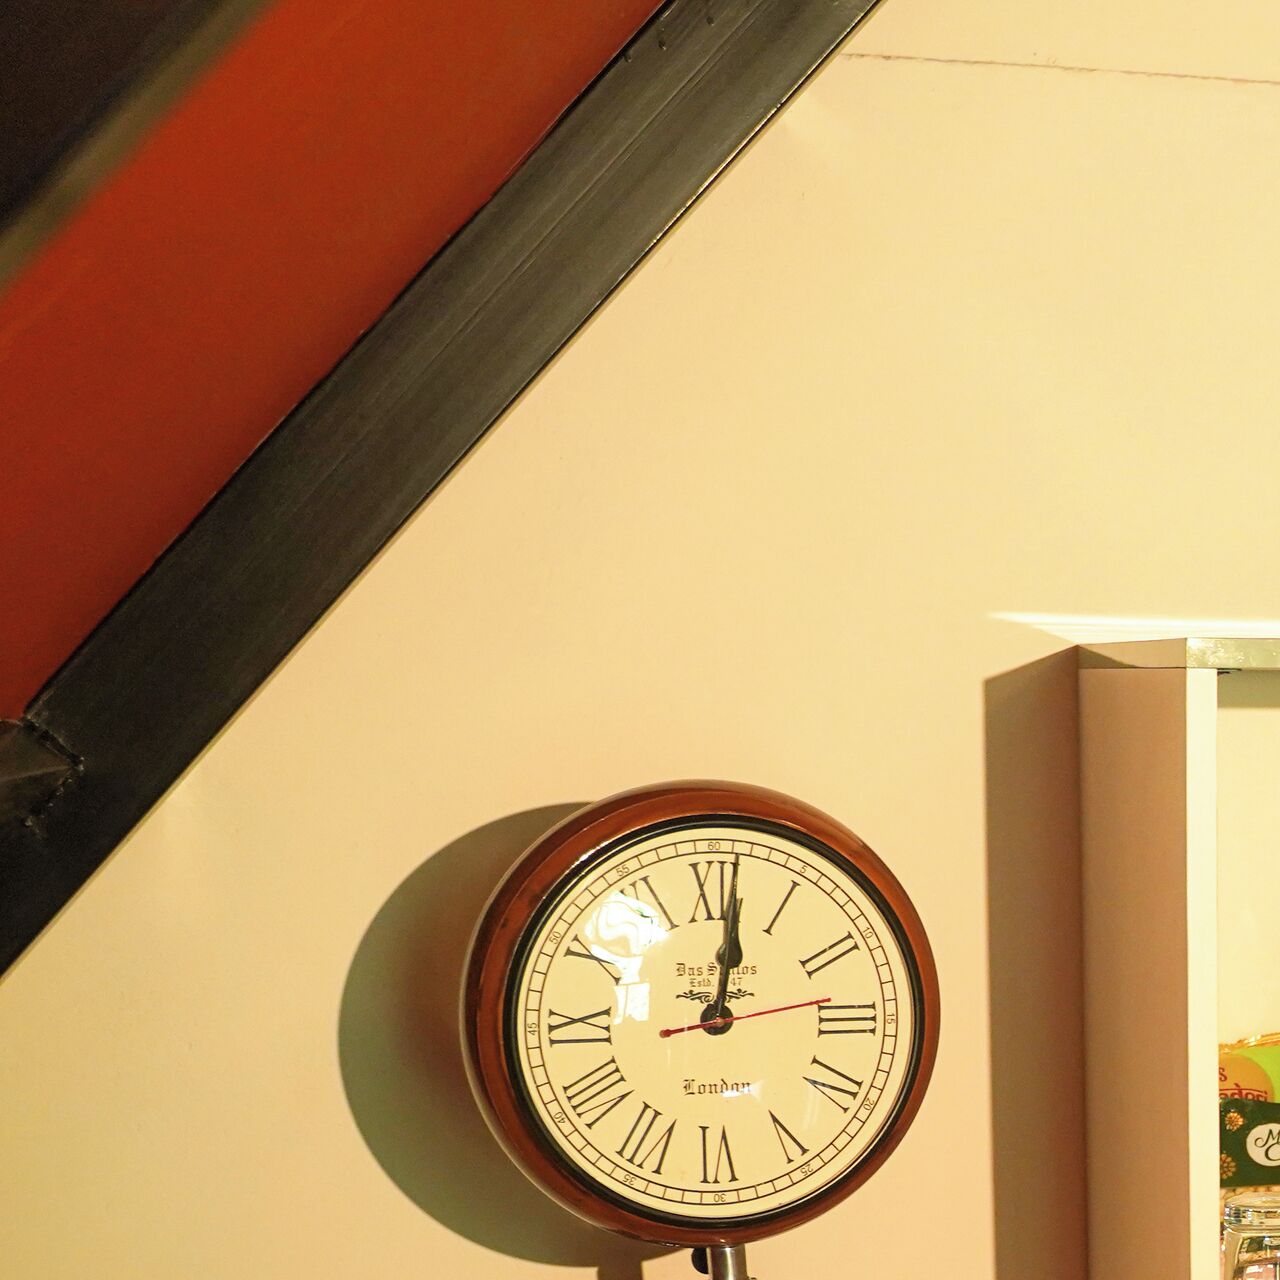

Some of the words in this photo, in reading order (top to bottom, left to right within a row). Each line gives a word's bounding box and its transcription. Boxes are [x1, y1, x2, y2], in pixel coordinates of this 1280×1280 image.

[708, 842, 720, 850] 60
[616, 864, 630, 876] 55
[799, 864, 808, 874] 5
[550, 931, 562, 944] 50
[862, 926, 874, 940] 10
[676, 962, 703, 976] Das
[817, 1001, 877, 1038] III
[886, 1012, 896, 1025] 15
[528, 1022, 537, 1036] 45
[548, 1006, 612, 1047] IX
[683, 1078, 752, 1096] London
[863, 1097, 875, 1111] 20
[554, 1111, 566, 1124] 40
[768, 1109, 809, 1164] V
[698, 1125, 739, 1184] VI
[800, 1164, 814, 1177] 25
[623, 1173, 637, 1186] 35
[714, 1193, 727, 1202] 30
